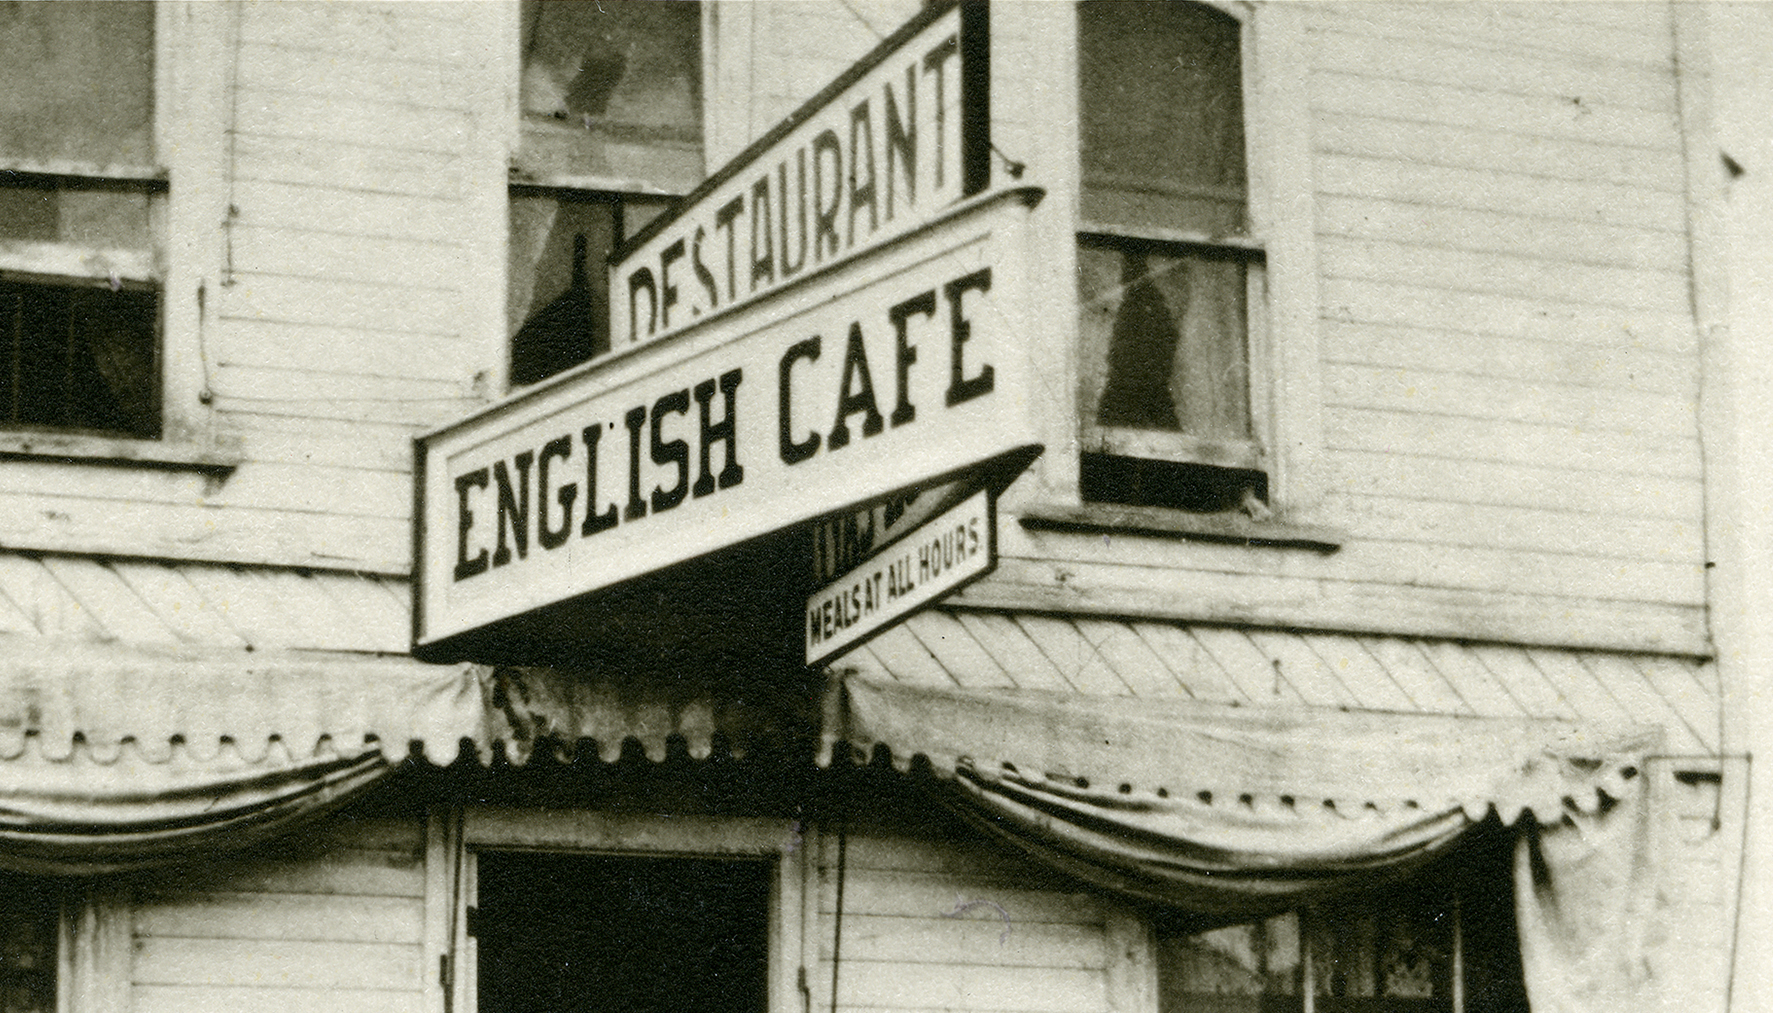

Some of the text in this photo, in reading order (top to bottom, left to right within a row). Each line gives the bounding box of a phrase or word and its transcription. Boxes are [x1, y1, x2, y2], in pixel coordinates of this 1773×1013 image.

[628, 32, 959, 343] RESTAURANT
[454, 367, 744, 582] ENGLISH
[778, 268, 995, 466] CAFE
[810, 584, 861, 646] MEALS
[864, 571, 882, 615] AT
[888, 554, 914, 602] ALL
[919, 517, 979, 585] HOURS
